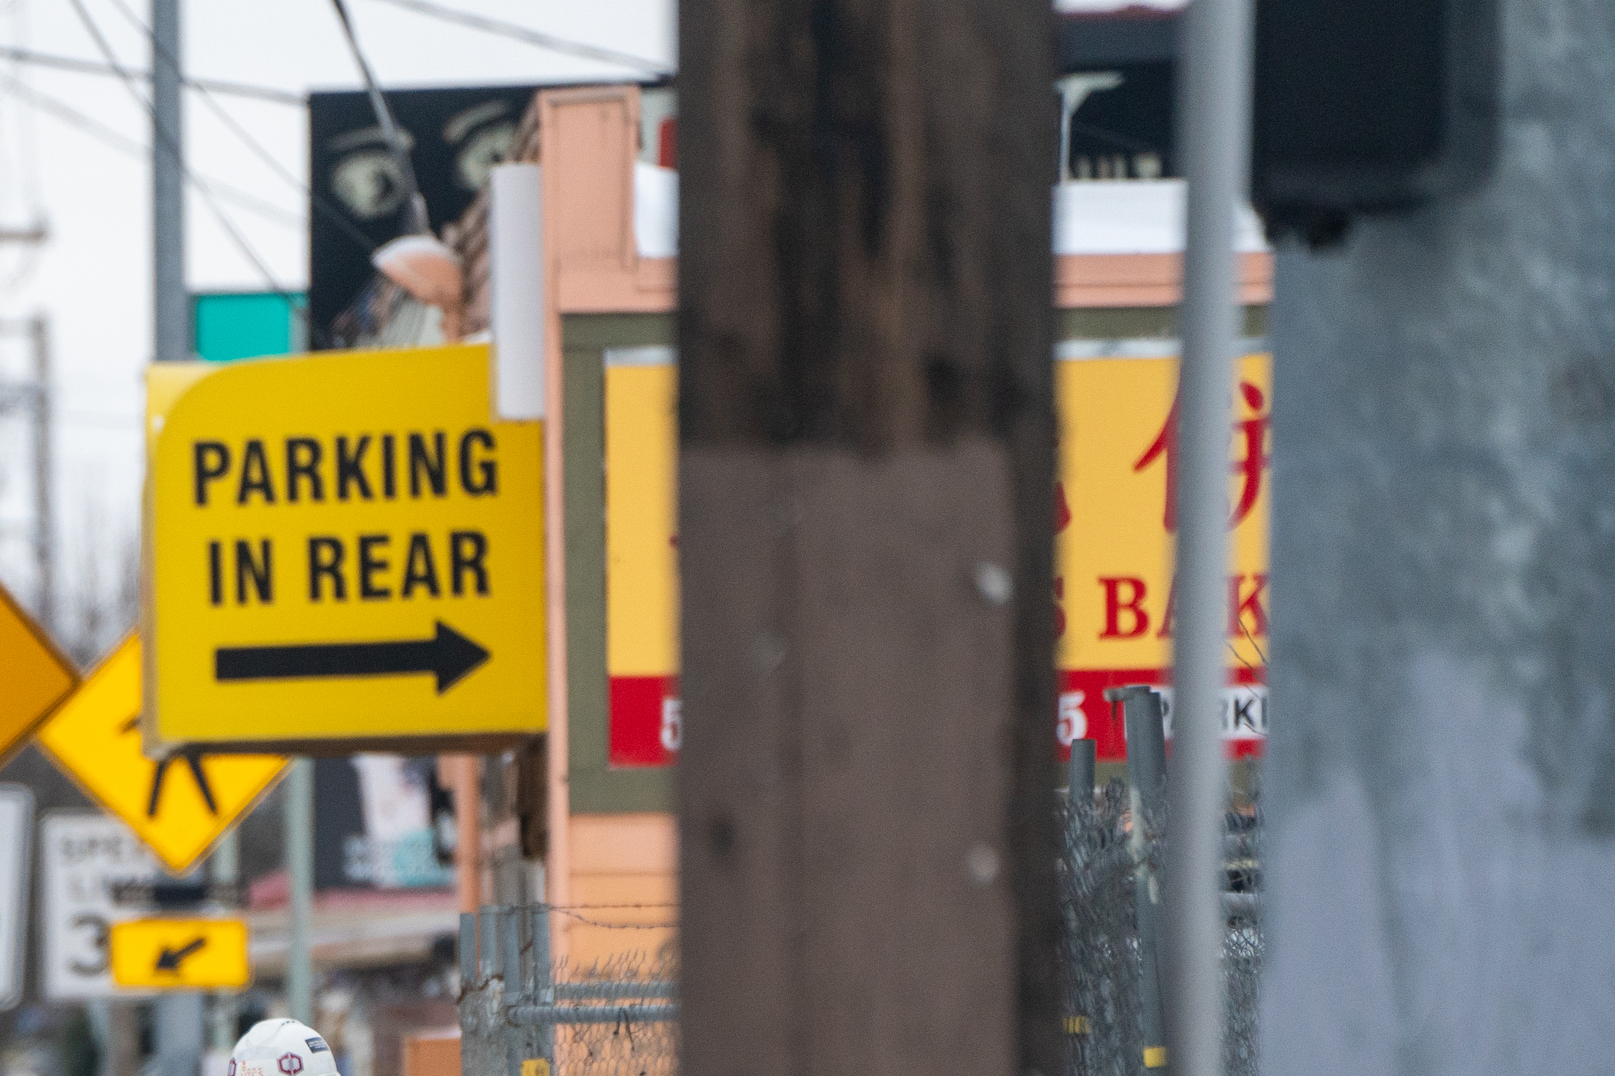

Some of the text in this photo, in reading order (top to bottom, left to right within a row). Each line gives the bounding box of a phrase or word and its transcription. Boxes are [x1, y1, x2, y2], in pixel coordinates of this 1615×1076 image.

[192, 428, 498, 506] PARKING
[208, 529, 490, 606] IN REAR
